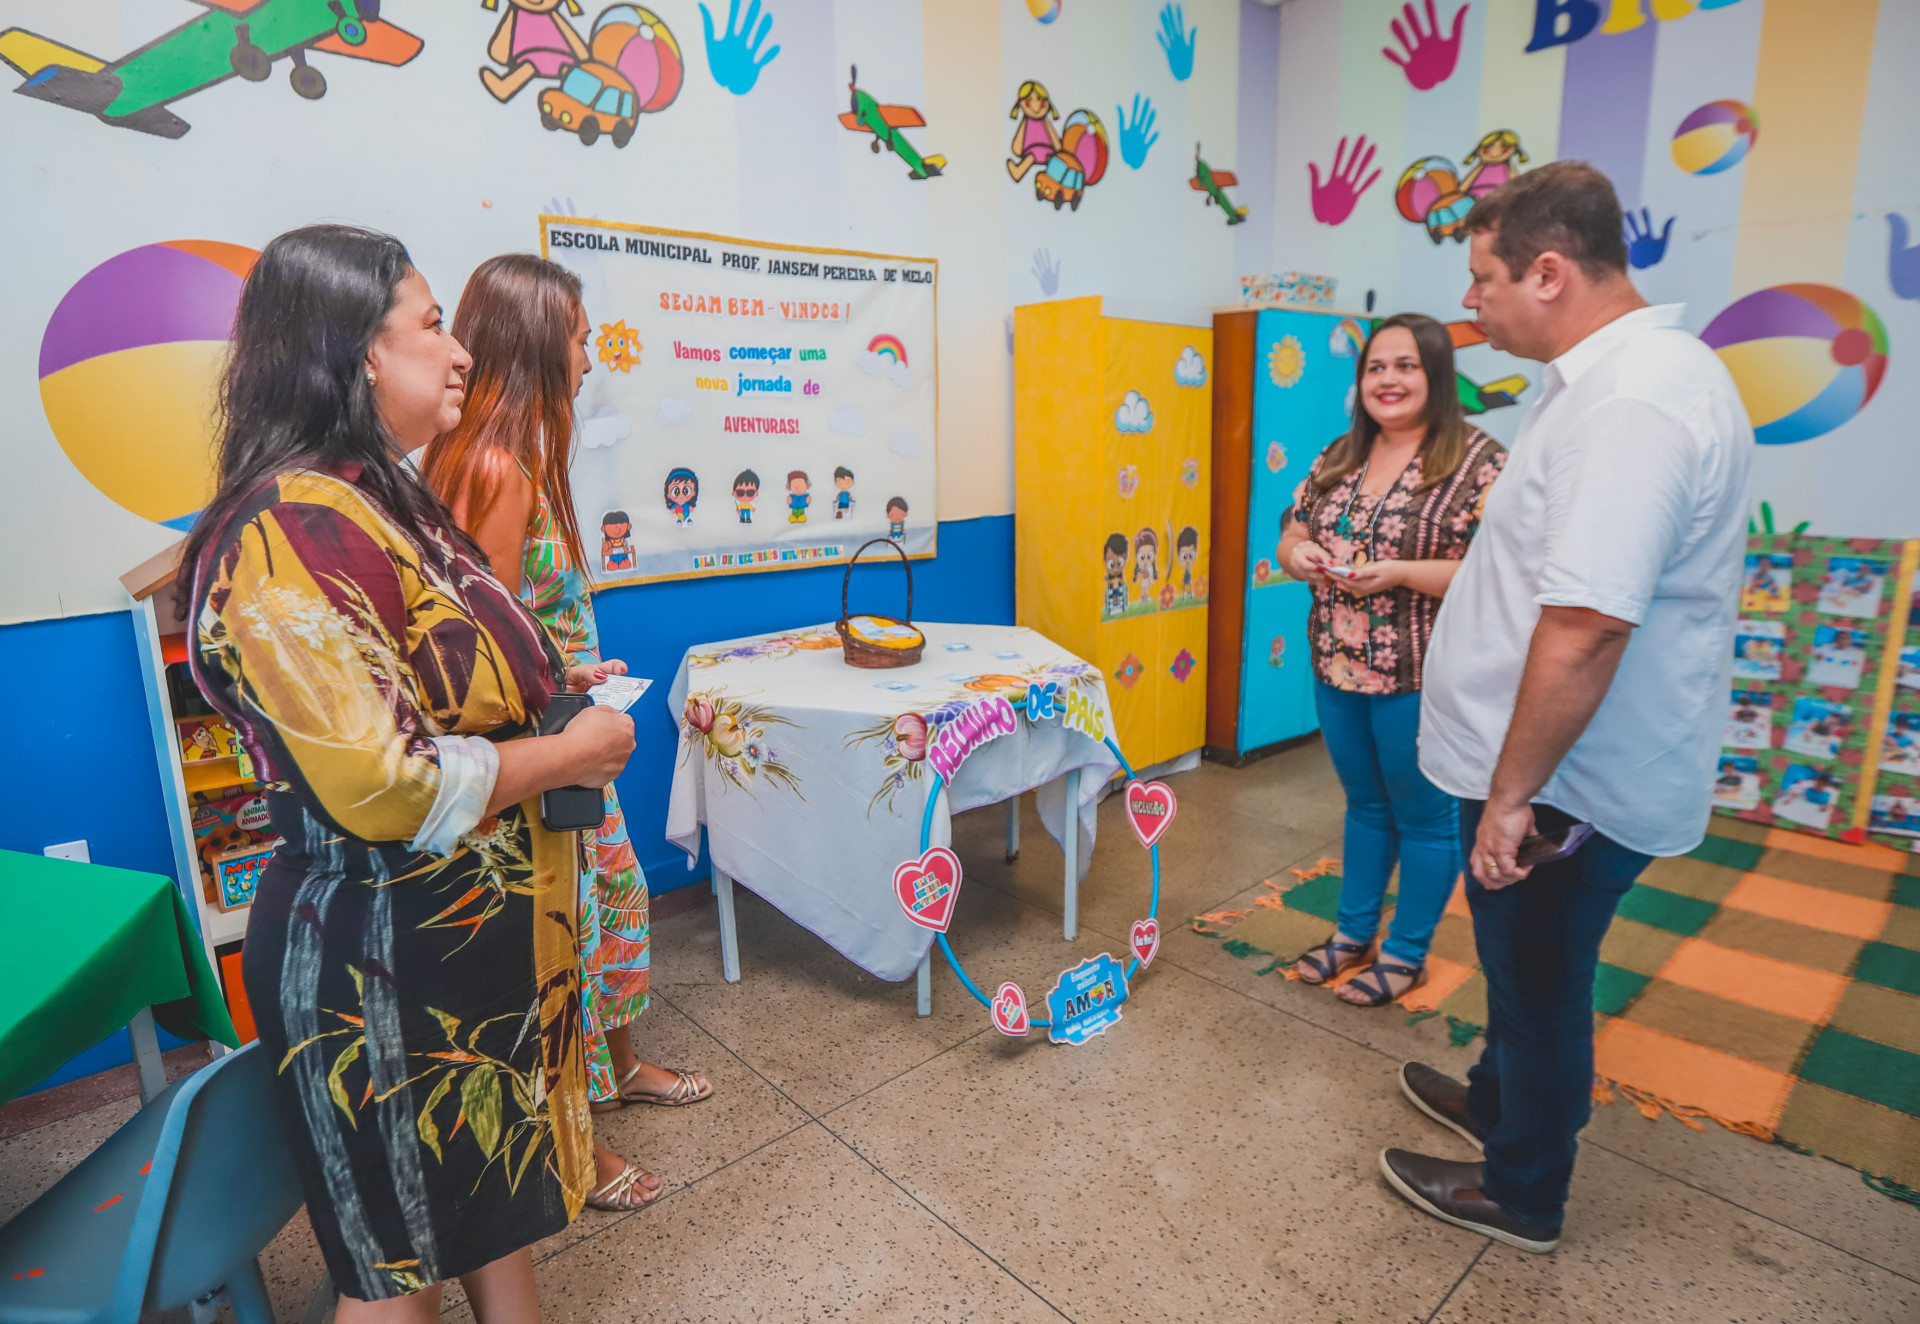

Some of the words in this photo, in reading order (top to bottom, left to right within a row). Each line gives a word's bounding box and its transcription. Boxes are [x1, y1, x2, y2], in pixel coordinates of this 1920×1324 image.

[550, 230, 620, 252] ESCOLA
[625, 237, 712, 264] MUNICIPAL
[722, 251, 761, 271] PROF.
[768, 259, 819, 277] JANSEM
[823, 265, 877, 281] PEREIRA
[884, 268, 897, 282] DE
[902, 270, 933, 283] MELO
[659, 292, 722, 314] SEJAM
[673, 340, 721, 362] Vamos
[729, 346, 792, 365] começar
[799, 347, 827, 361] uma
[695, 376, 729, 391] nova
[736, 372, 792, 397] jornada
[803, 379, 820, 395] de
[724, 415, 800, 434] AVENTURAS!
[722, 554, 733, 565] DE
[1027, 682, 1058, 721] DE
[1064, 690, 1106, 742] PAIS
